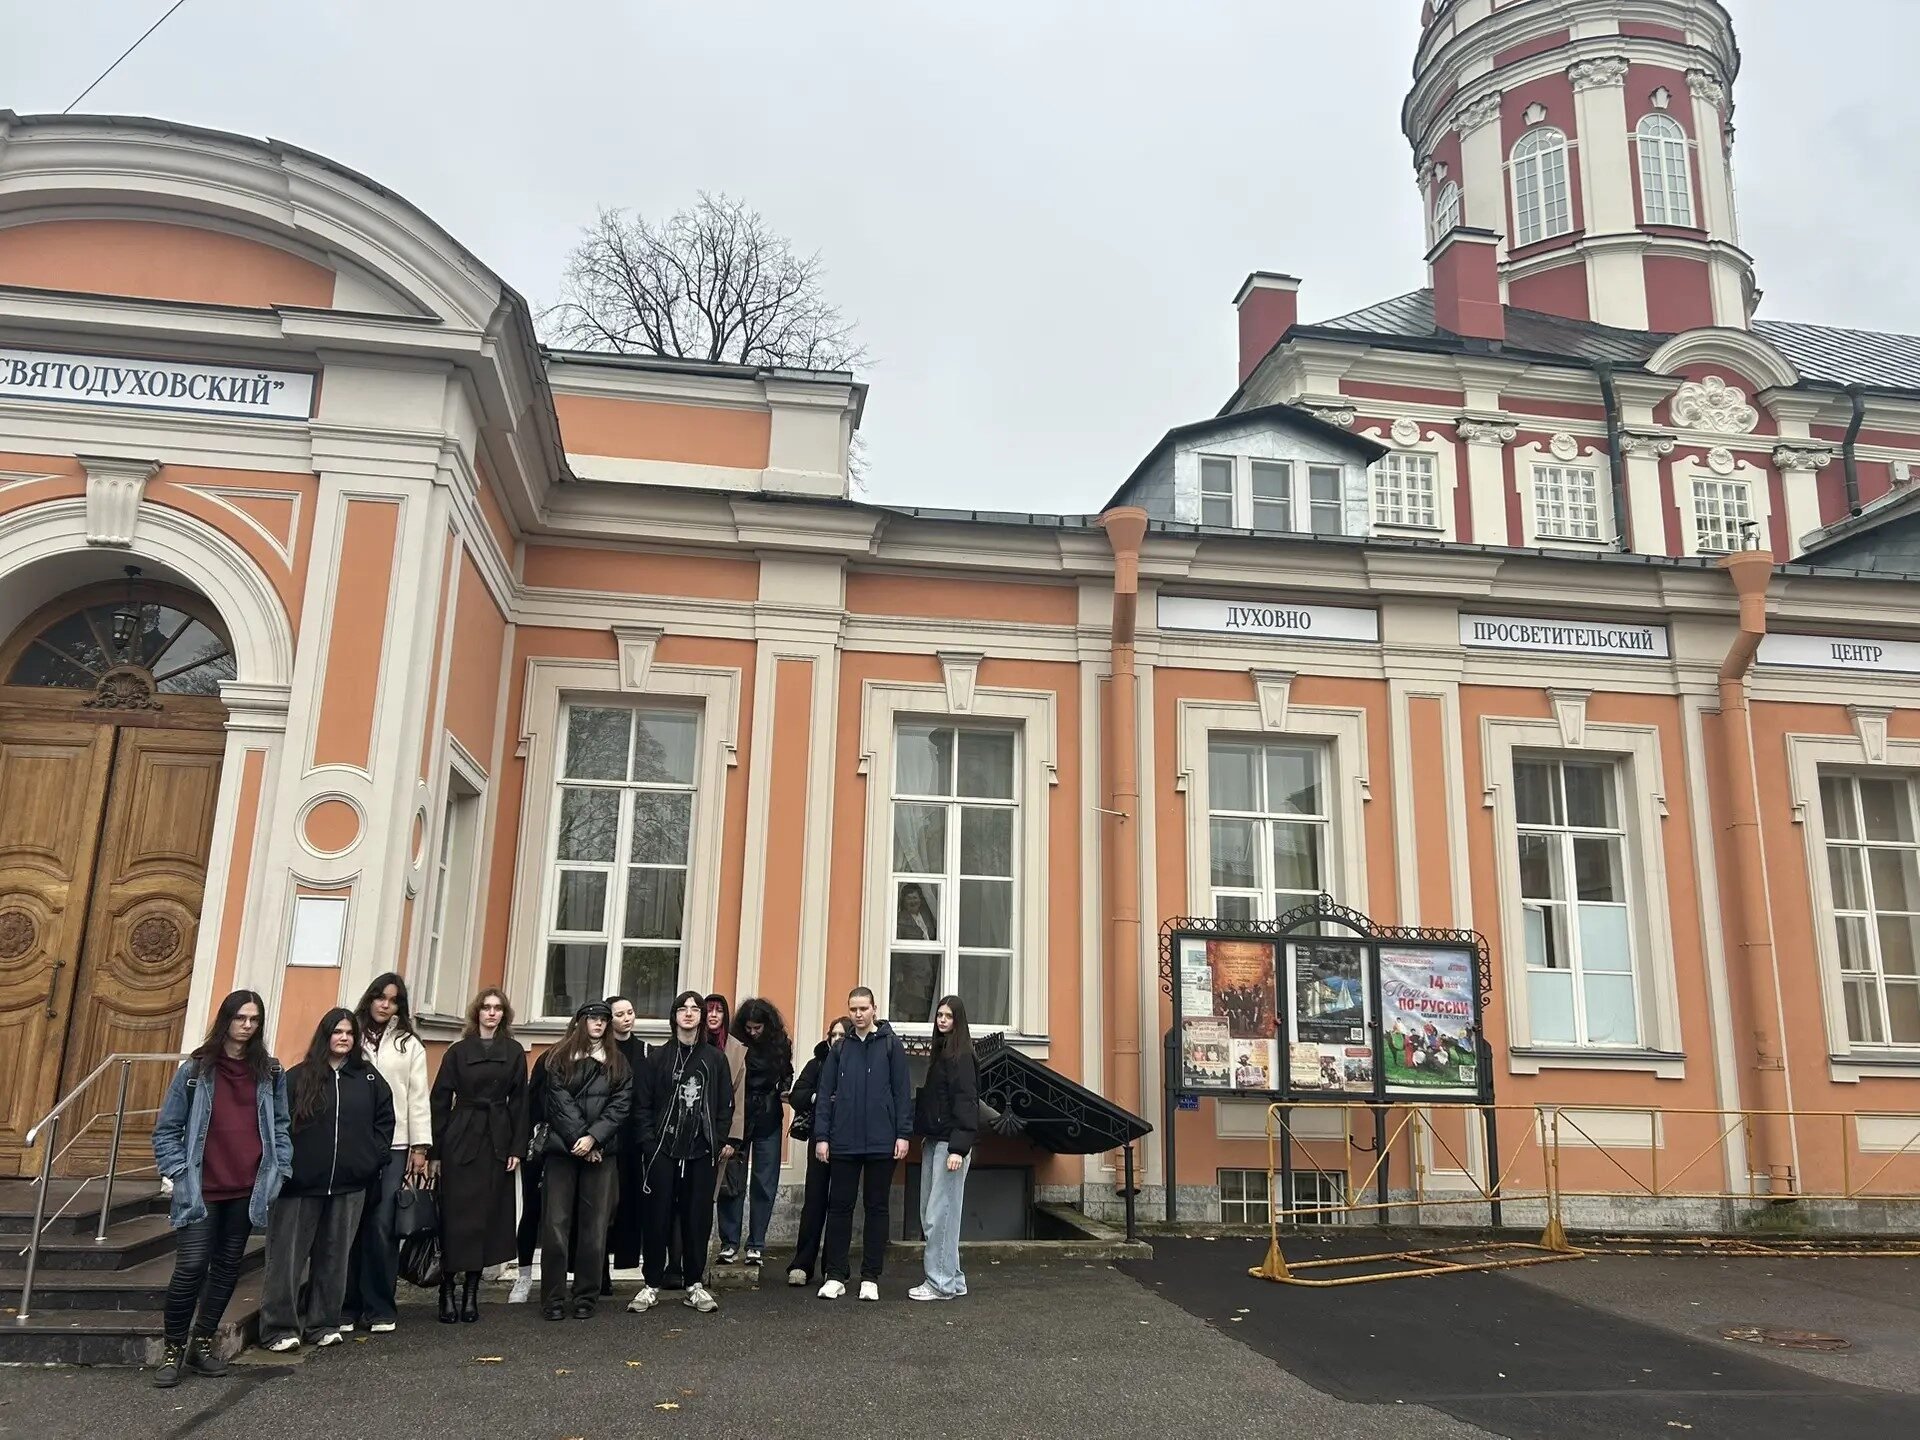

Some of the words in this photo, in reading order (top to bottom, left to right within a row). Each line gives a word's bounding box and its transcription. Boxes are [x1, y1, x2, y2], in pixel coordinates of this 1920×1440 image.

[1226, 606, 1311, 630] ДУХОВНО
[1473, 622, 1654, 650] ПРОСВЕТИТЕЛЬСКИЙ
[1830, 643, 1883, 663] ЦЕНТР
[1429, 975, 1444, 990] 14
[1398, 998, 1469, 1015] ПО-РУССКИ
